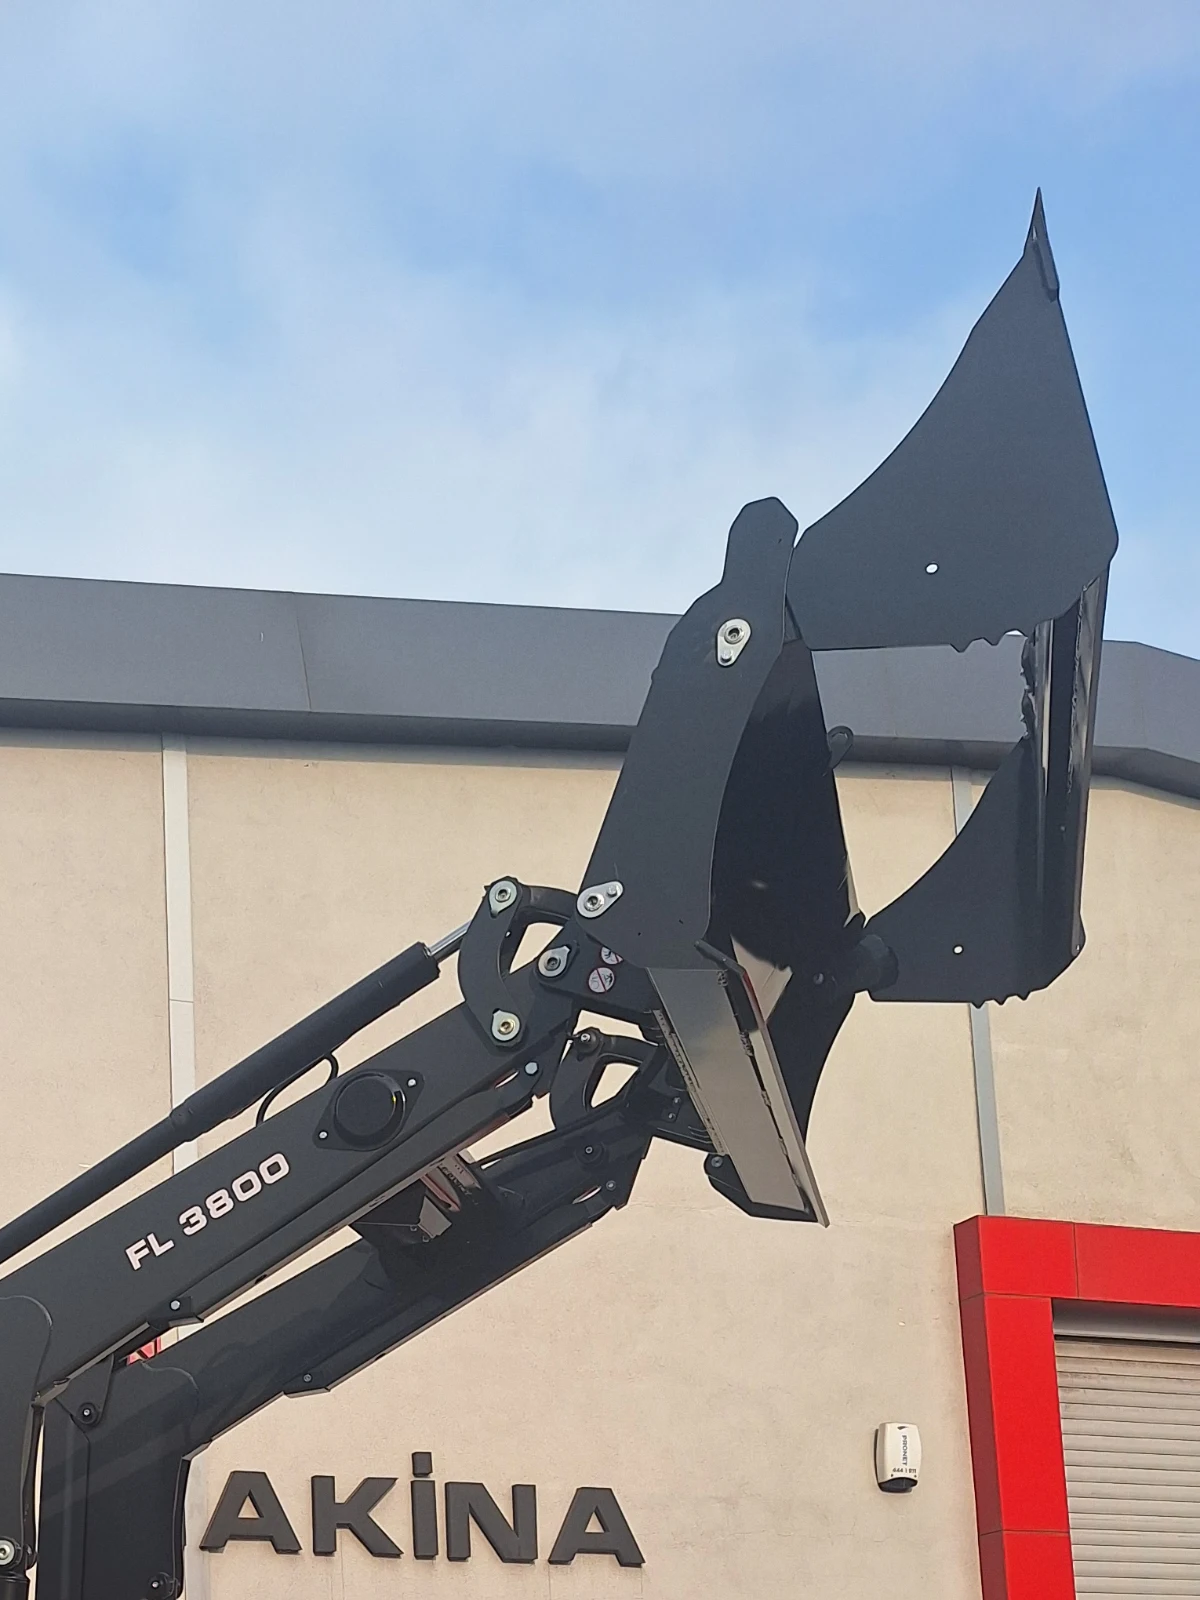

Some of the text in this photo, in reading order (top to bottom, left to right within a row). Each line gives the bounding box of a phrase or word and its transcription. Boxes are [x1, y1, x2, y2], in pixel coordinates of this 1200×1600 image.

[125, 1152, 290, 1271] FL 3800
[198, 1451, 647, 1567] AKİNA
